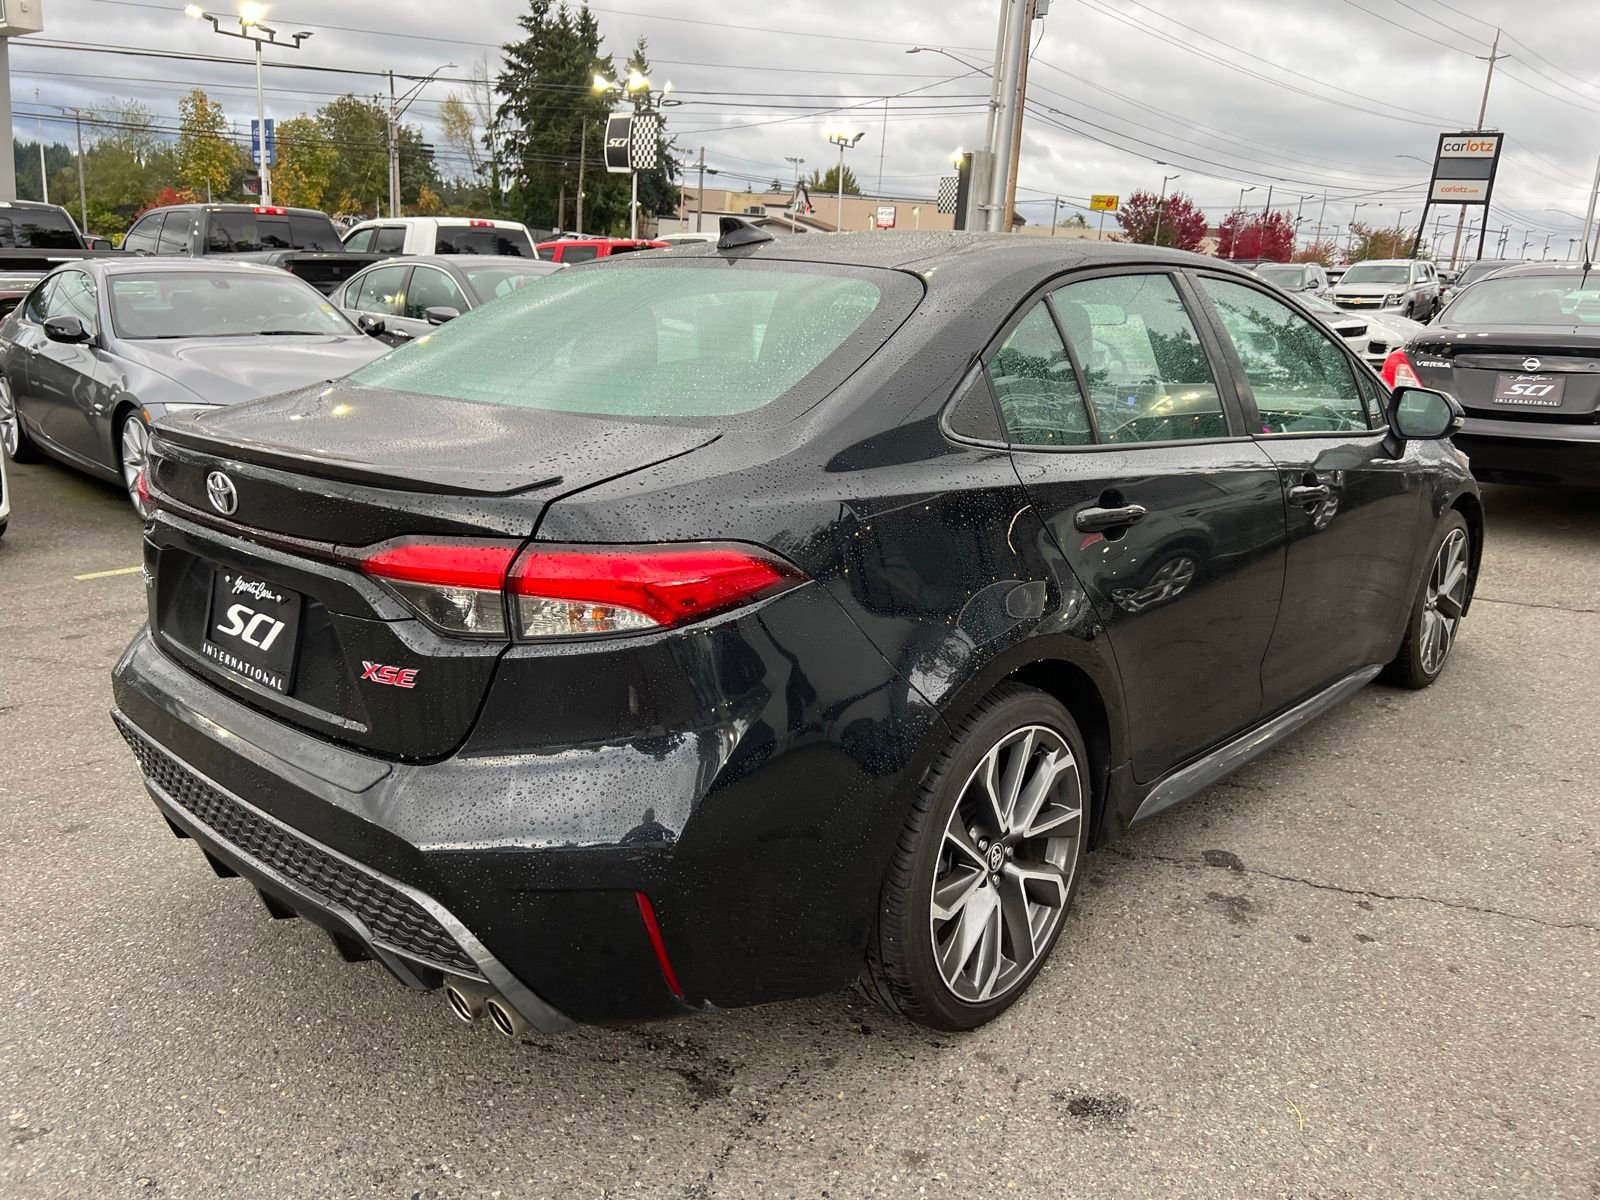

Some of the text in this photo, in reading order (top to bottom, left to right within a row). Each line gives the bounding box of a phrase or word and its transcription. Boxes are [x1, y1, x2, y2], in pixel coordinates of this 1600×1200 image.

[606, 138, 629, 147] SCI
[1444, 140, 1493, 151] carlotz
[1416, 360, 1451, 368] VERSA
[1503, 384, 1555, 396] SCI
[1494, 398, 1558, 406] INTERNATIONAL
[216, 603, 285, 652] SCI
[203, 643, 282, 690] INTERNATIONAL
[360, 660, 420, 689] XSE
